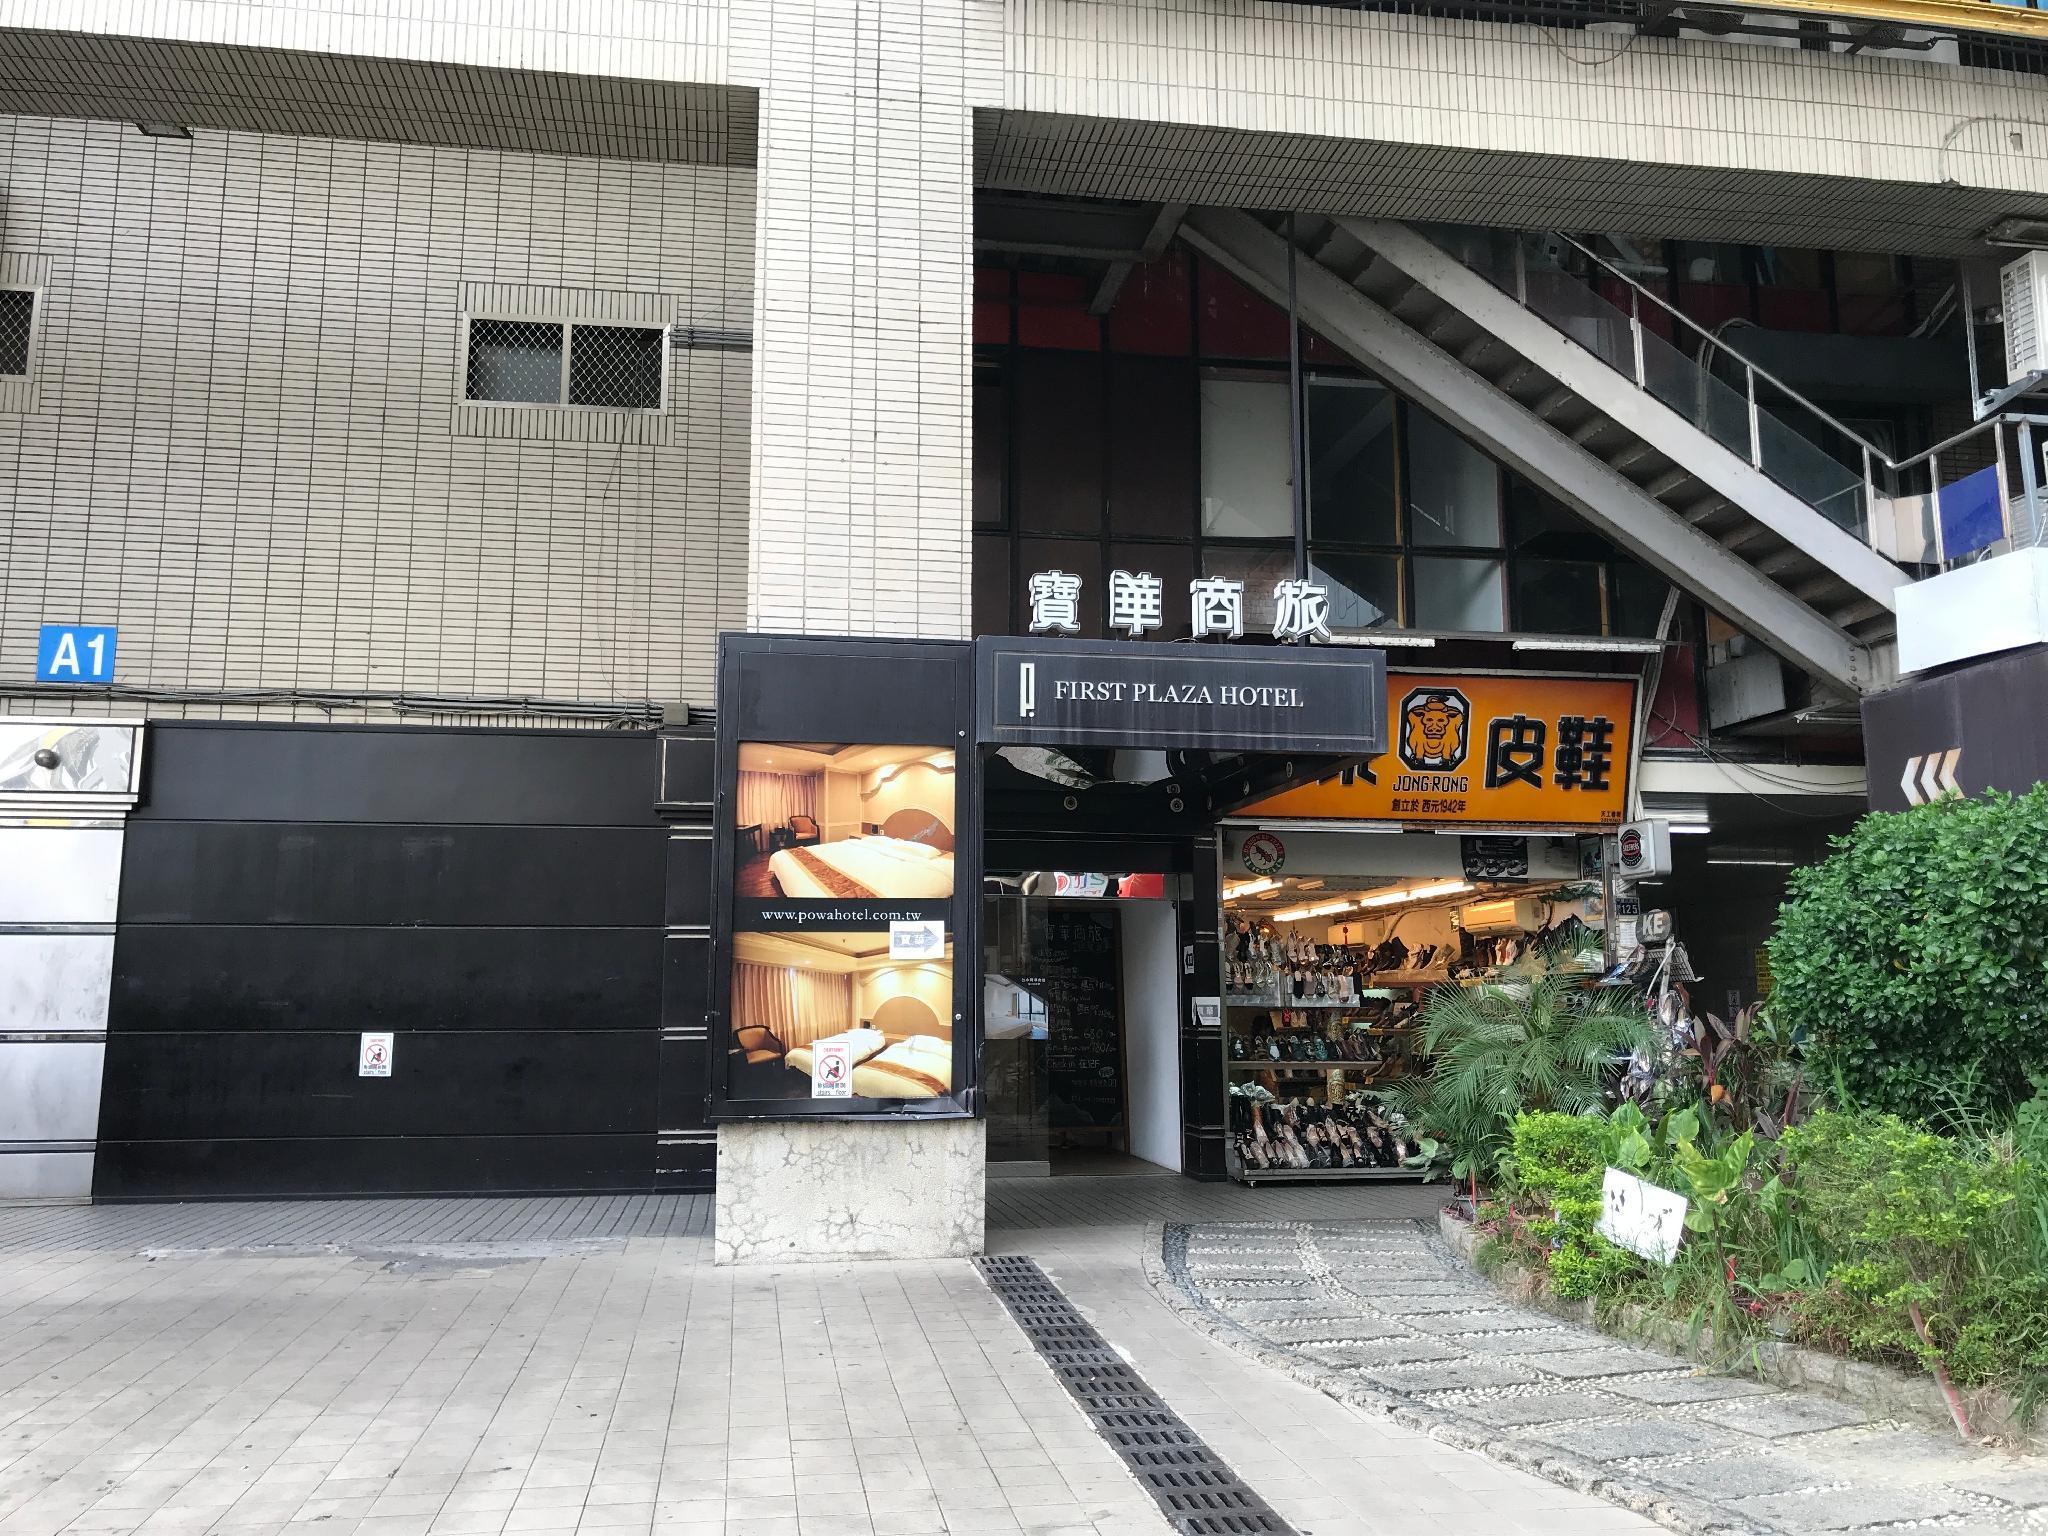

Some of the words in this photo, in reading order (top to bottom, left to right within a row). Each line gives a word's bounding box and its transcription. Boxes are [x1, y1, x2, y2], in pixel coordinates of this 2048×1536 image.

[1028, 569, 1332, 643] 寶華商旅
[49, 632, 105, 676] A1
[1053, 679, 1126, 702] FIRST
[1132, 683, 1214, 705] PLAZA
[1219, 685, 1304, 709] HOTEL
[1484, 713, 1615, 792] 皮鞋
[1392, 775, 1469, 793] JONG-RONG
[1392, 798, 1420, 812] 創立於
[1422, 798, 1466, 814] 西元1942年
[761, 908, 922, 924] www.powahotel.com.tw
[1621, 904, 1638, 914] 125
